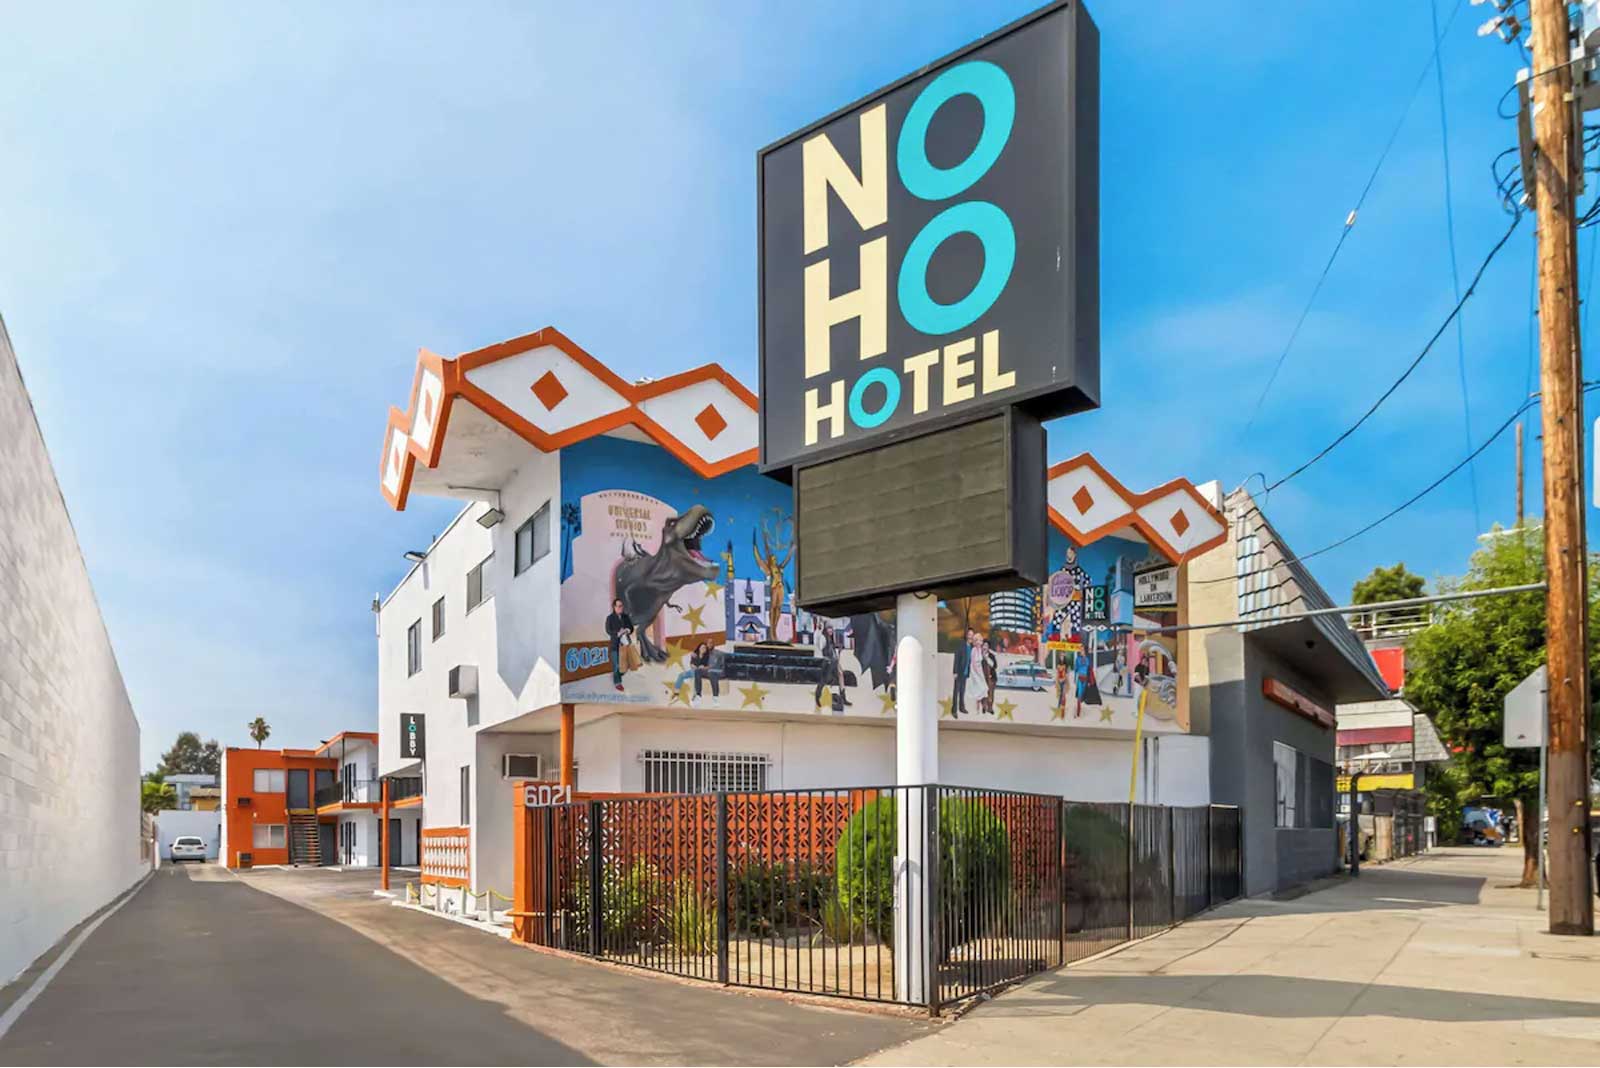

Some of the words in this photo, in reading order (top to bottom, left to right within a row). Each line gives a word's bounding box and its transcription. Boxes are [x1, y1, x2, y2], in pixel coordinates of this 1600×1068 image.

[803, 61, 1015, 255] NO
[804, 201, 1016, 379] HO
[804, 329, 1016, 446] HOTEL
[565, 646, 609, 672] 6021
[408, 715, 417, 756] LOBBY
[525, 785, 571, 807] 6021
